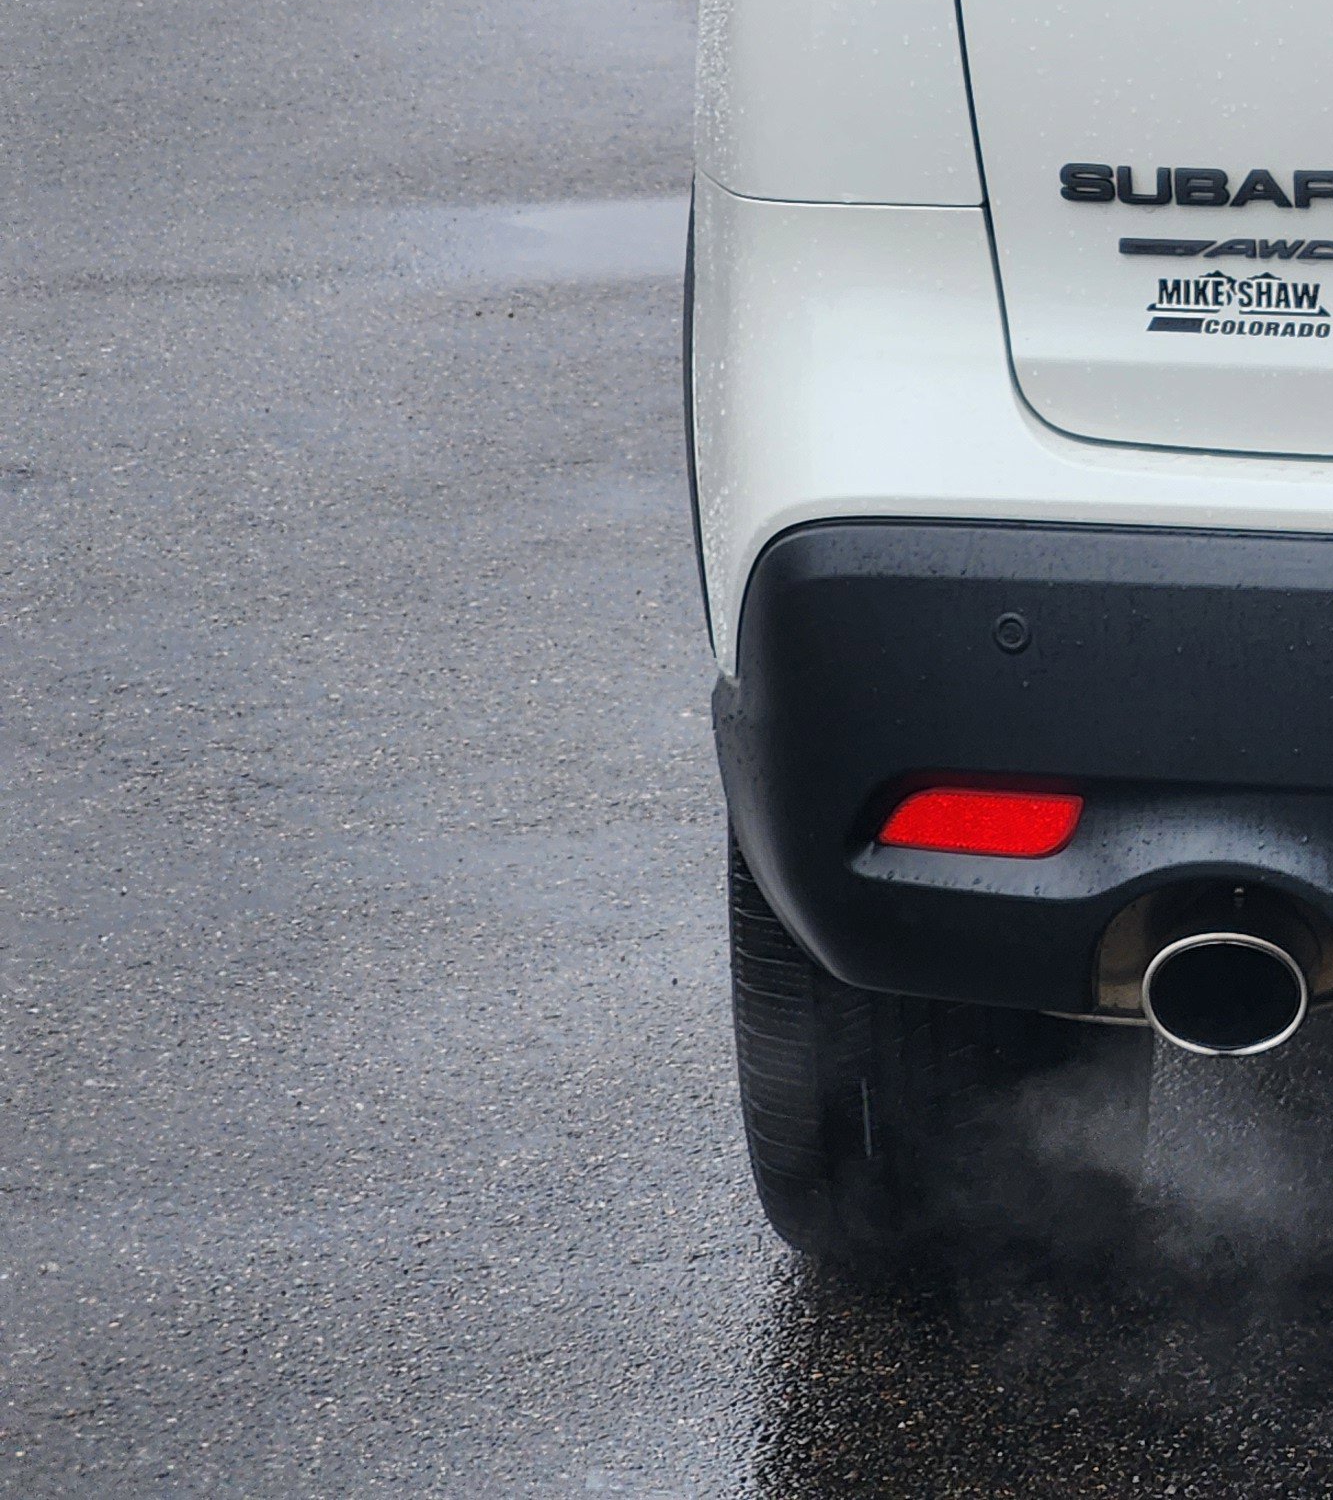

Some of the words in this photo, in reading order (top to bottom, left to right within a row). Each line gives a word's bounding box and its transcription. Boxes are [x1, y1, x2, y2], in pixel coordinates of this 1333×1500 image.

[1157, 278, 1225, 307] MIKE
[1238, 281, 1321, 311] SHAW
[1203, 319, 1332, 339] COLORADO
